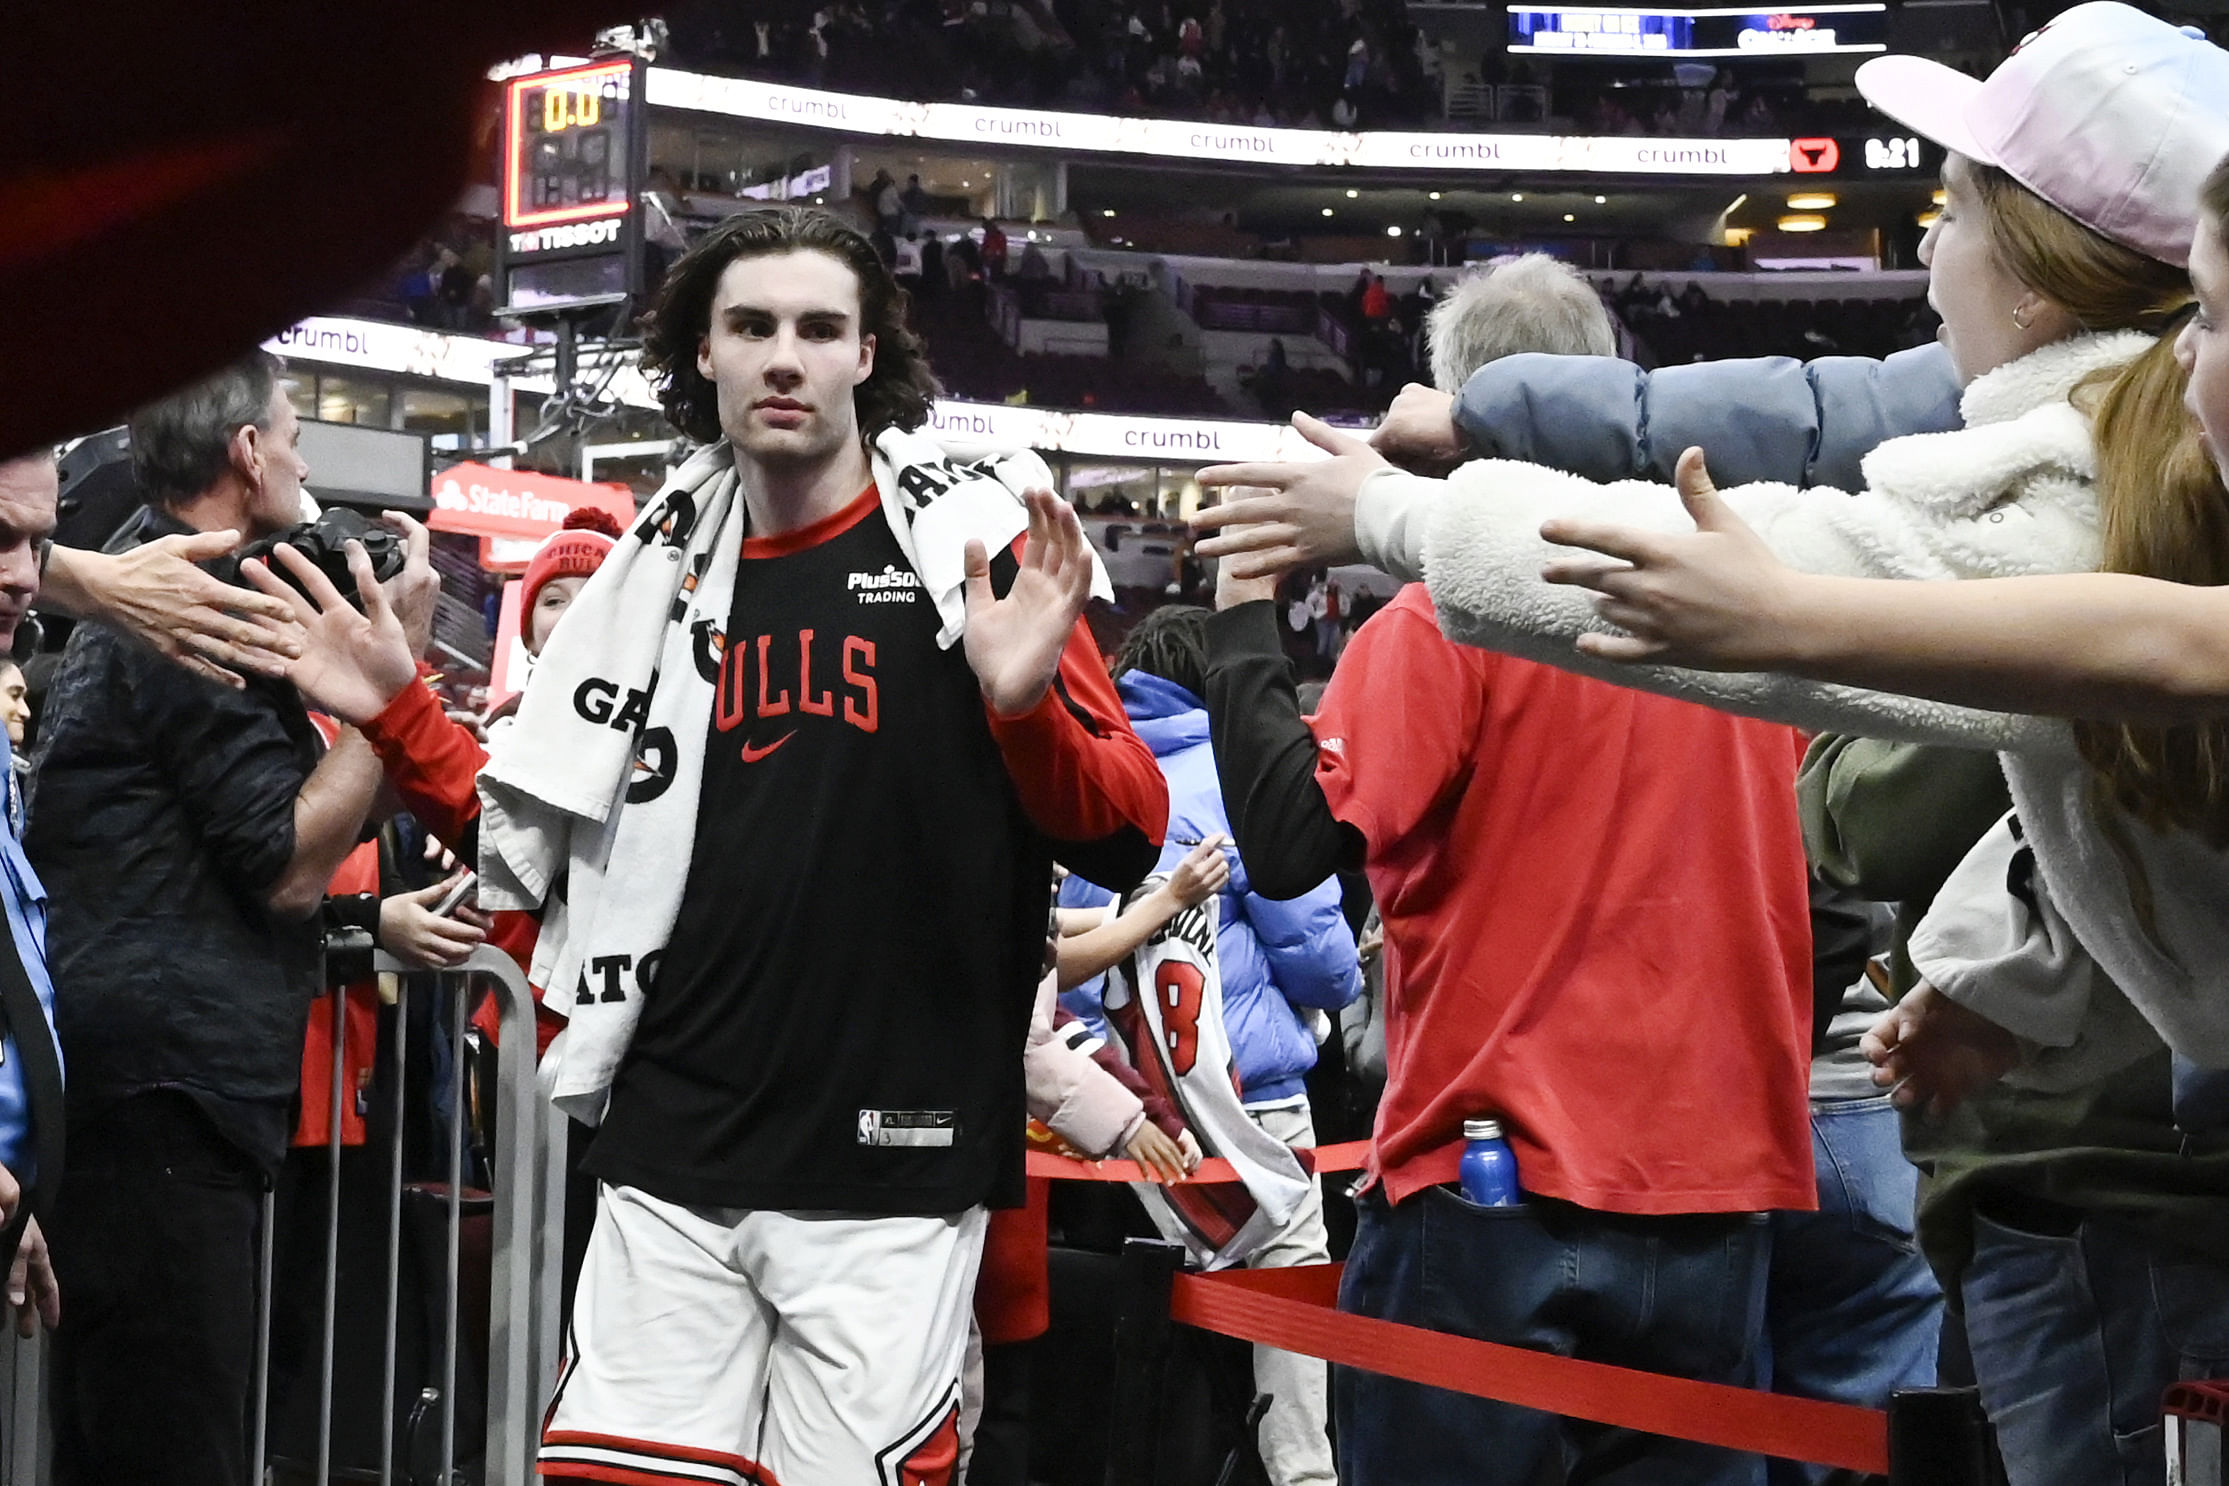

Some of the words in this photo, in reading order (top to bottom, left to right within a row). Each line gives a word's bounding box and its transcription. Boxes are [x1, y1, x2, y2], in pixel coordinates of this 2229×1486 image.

[768, 96, 847, 120] crumbl
[975, 116, 1061, 137] crumbl
[1190, 133, 1275, 153] crumbl
[1409, 143, 1500, 159] crumbl
[1637, 148, 1728, 164] crumbl
[540, 219, 622, 249] TISSOT
[278, 326, 368, 354] crumbl
[932, 413, 995, 434] umbl
[1125, 429, 1221, 449] crumbl
[857, 591, 915, 604] TRADING
[716, 629, 879, 734] ULLS
[1155, 958, 1206, 1077] 8
